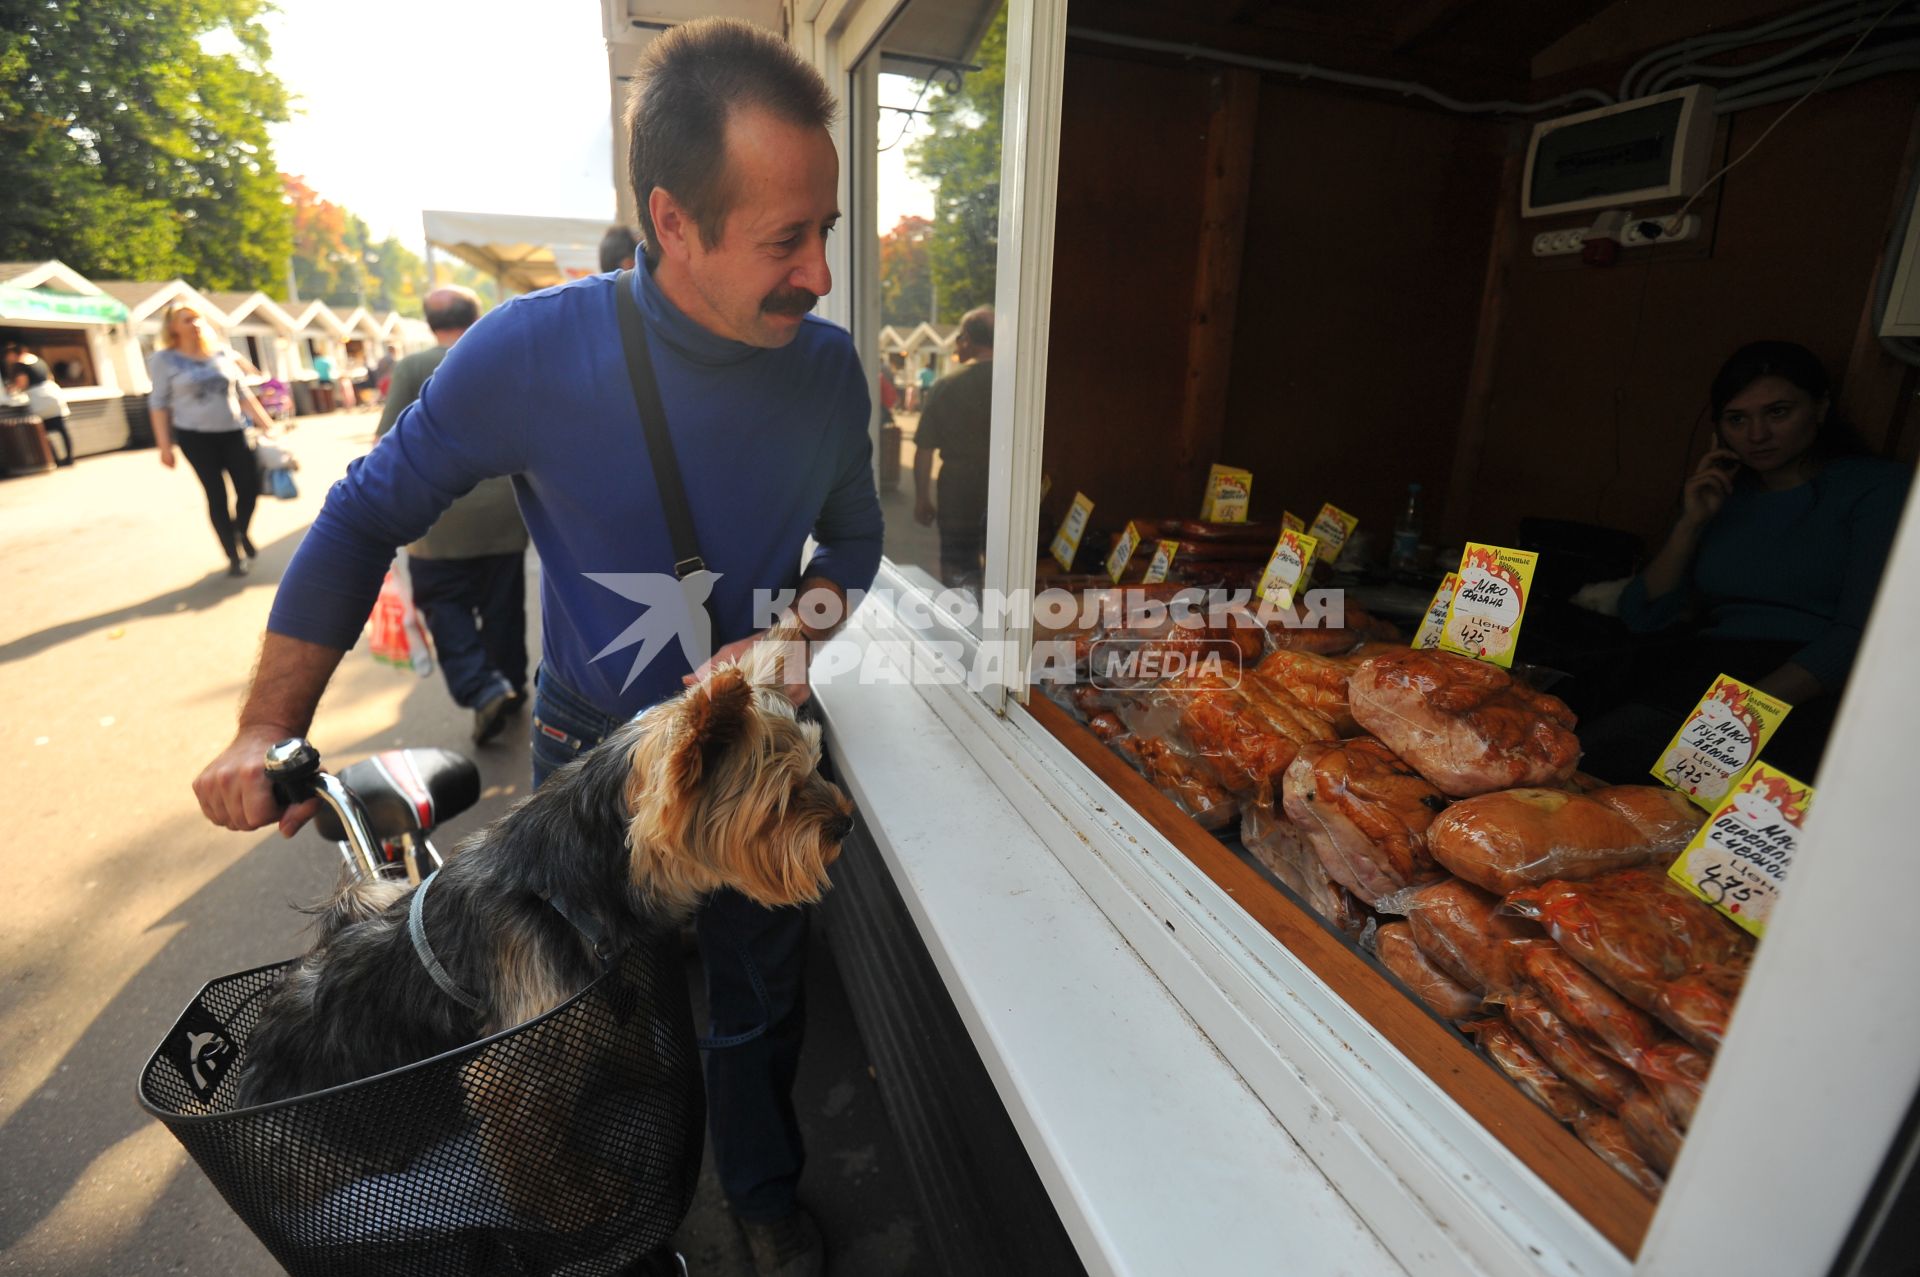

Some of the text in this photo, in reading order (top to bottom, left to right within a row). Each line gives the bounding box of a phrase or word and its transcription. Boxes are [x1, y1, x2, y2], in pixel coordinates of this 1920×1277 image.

[1462, 589, 1504, 607] ФАЗАНА
[1471, 617, 1509, 634] Цена
[1692, 752, 1729, 778] Цена
